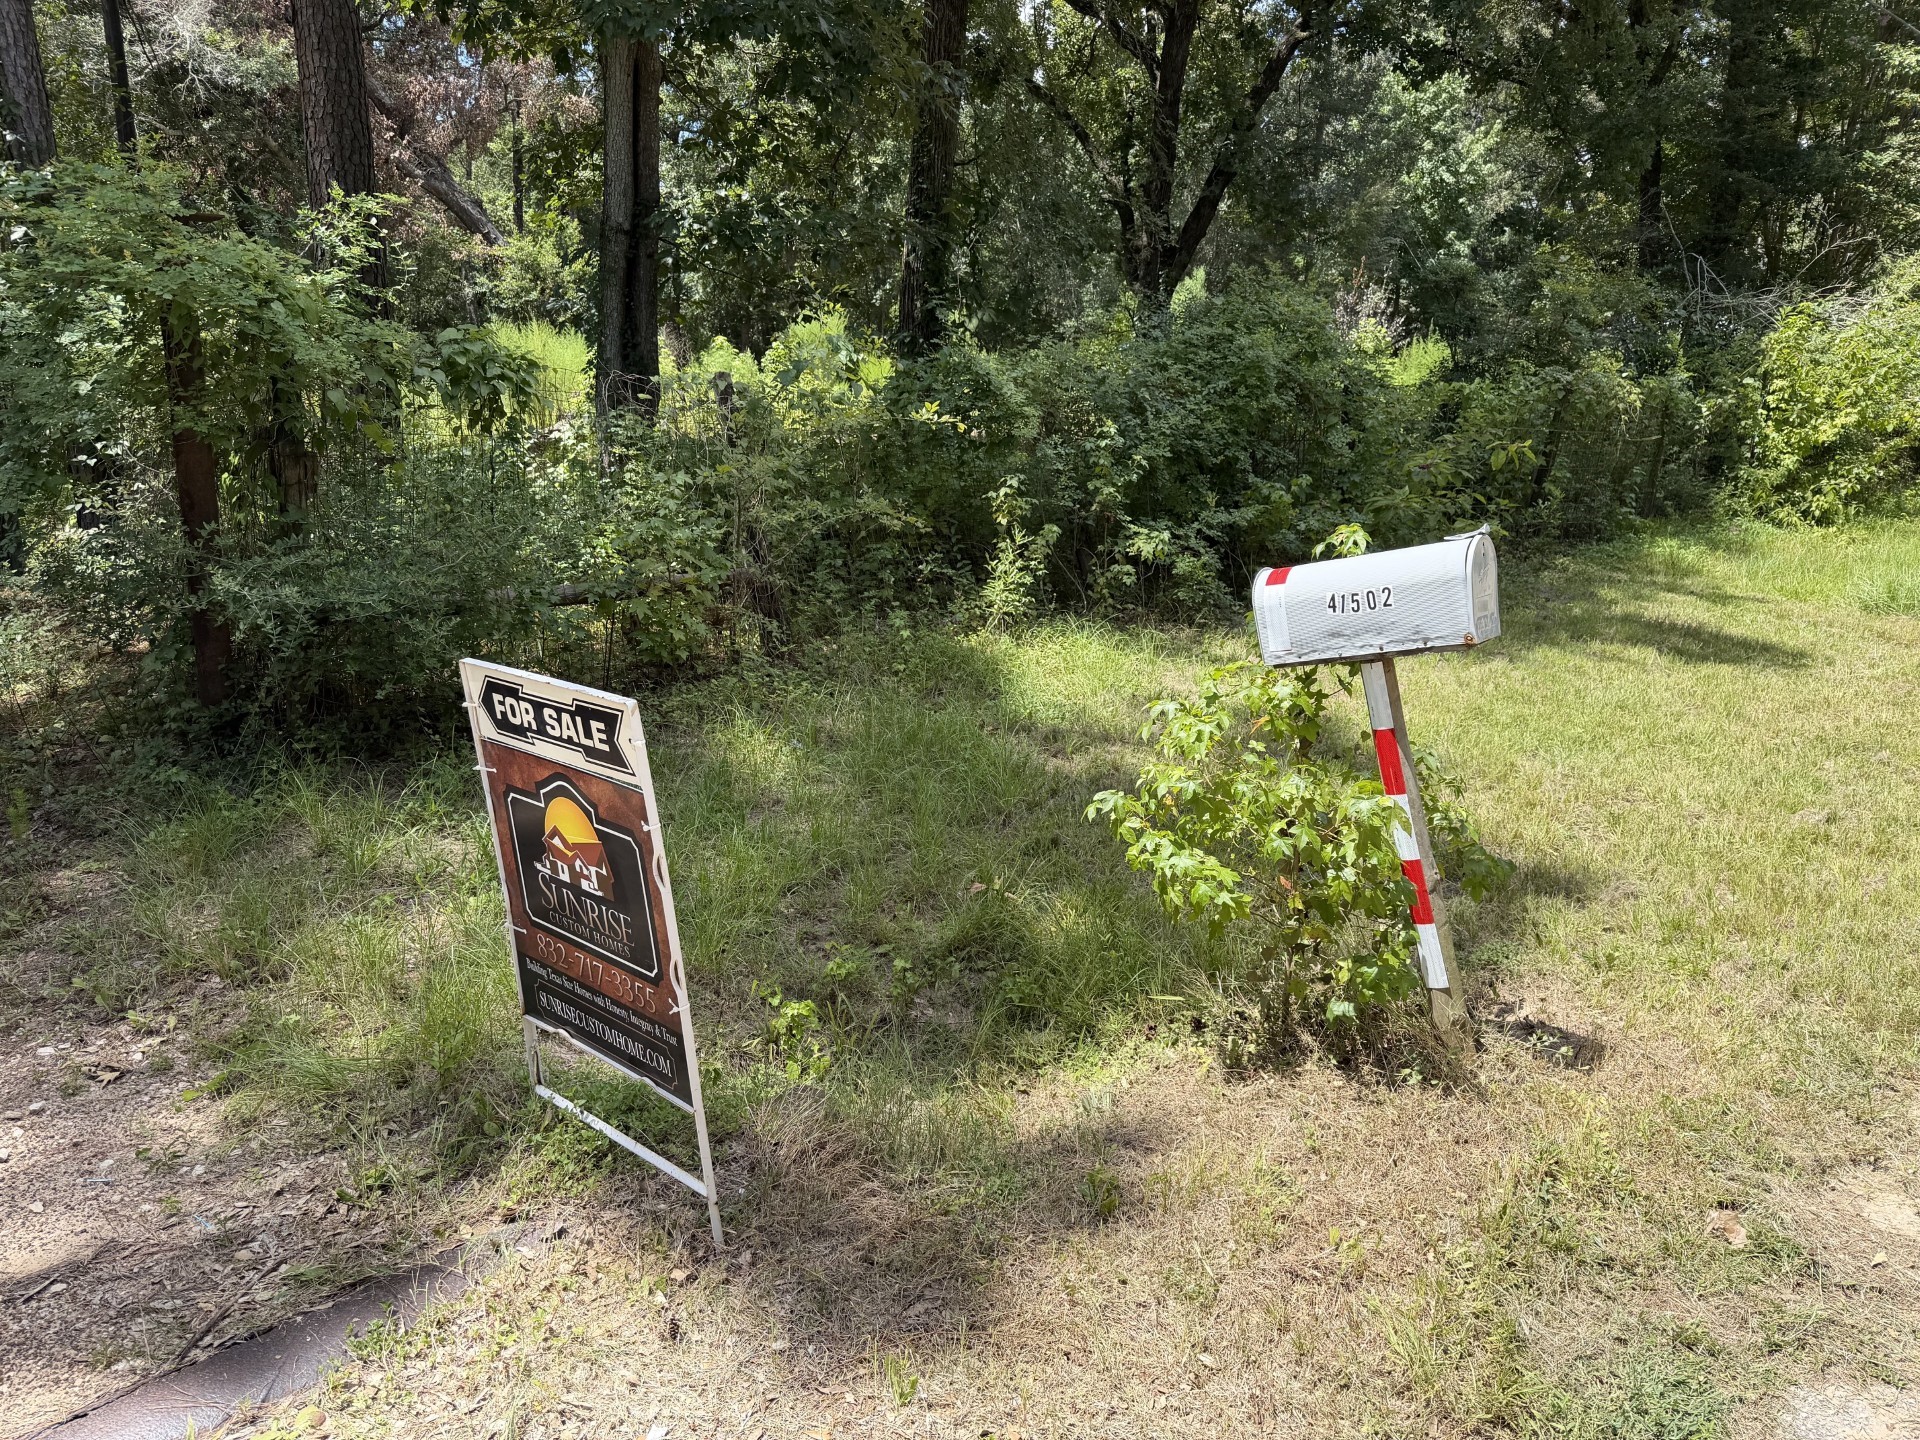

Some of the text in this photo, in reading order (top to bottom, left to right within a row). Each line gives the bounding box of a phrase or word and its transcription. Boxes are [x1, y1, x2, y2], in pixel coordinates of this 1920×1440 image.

[1328, 587, 1392, 613] 41502
[492, 693, 610, 752] FOR SALE
[538, 872, 634, 947] SUNRISE
[550, 911, 631, 958] CUSTOM HOMES
[526, 957, 678, 1047] Building Texas Size Homes with Honesty, Integrity & Trust
[537, 934, 656, 1013] 832-717-3355
[539, 990, 673, 1078] SUNRISECUSTOMHOME.COM
